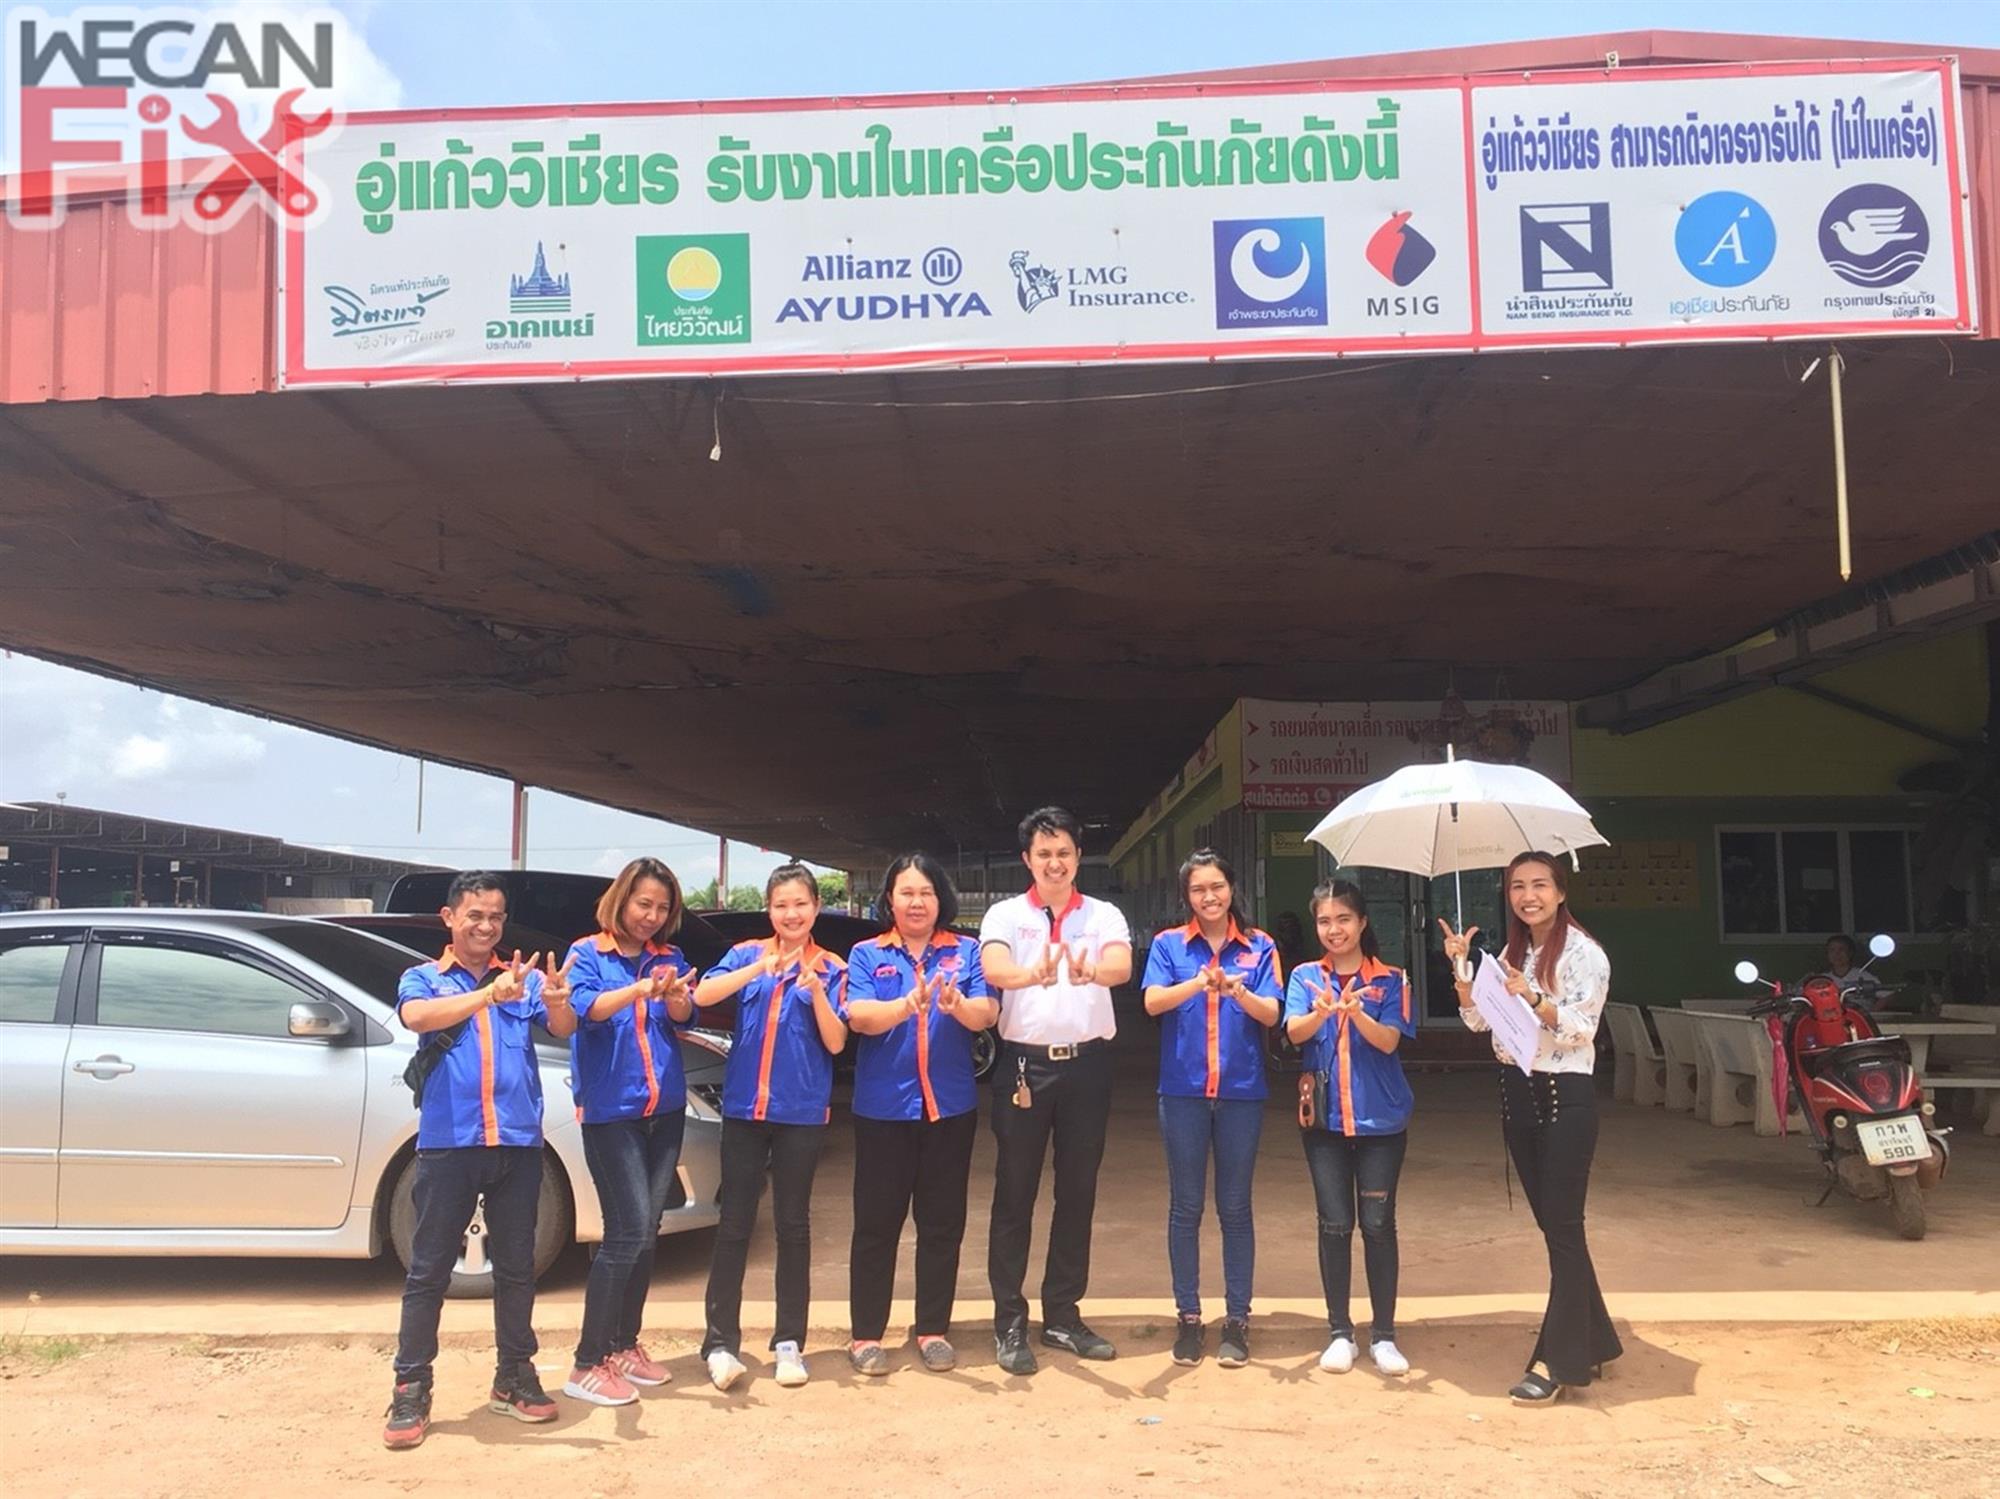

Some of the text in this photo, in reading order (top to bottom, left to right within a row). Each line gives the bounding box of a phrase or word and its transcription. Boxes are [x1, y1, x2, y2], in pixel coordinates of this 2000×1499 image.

[1482, 112, 1600, 190] อู่แก้ววิเชียร
[356, 98, 1401, 234] อู่แก้ววิเชียร รับงานในเครือประกันภัยดังนี้
[801, 255, 911, 283] Allianz
[1067, 266, 1128, 286] LMG
[775, 292, 992, 323] AYUDHYA
[1367, 296, 1439, 317] MSIG
[1823, 291, 1935, 311] กรุงเทพประกันภัย
[486, 313, 595, 339] อาคเนย์
[1506, 312, 1528, 320] NAM
[1559, 309, 1611, 318] INSURANCE
[644, 315, 744, 338] ไทยวิวัฒน์
[1883, 1145, 1916, 1159] 590
